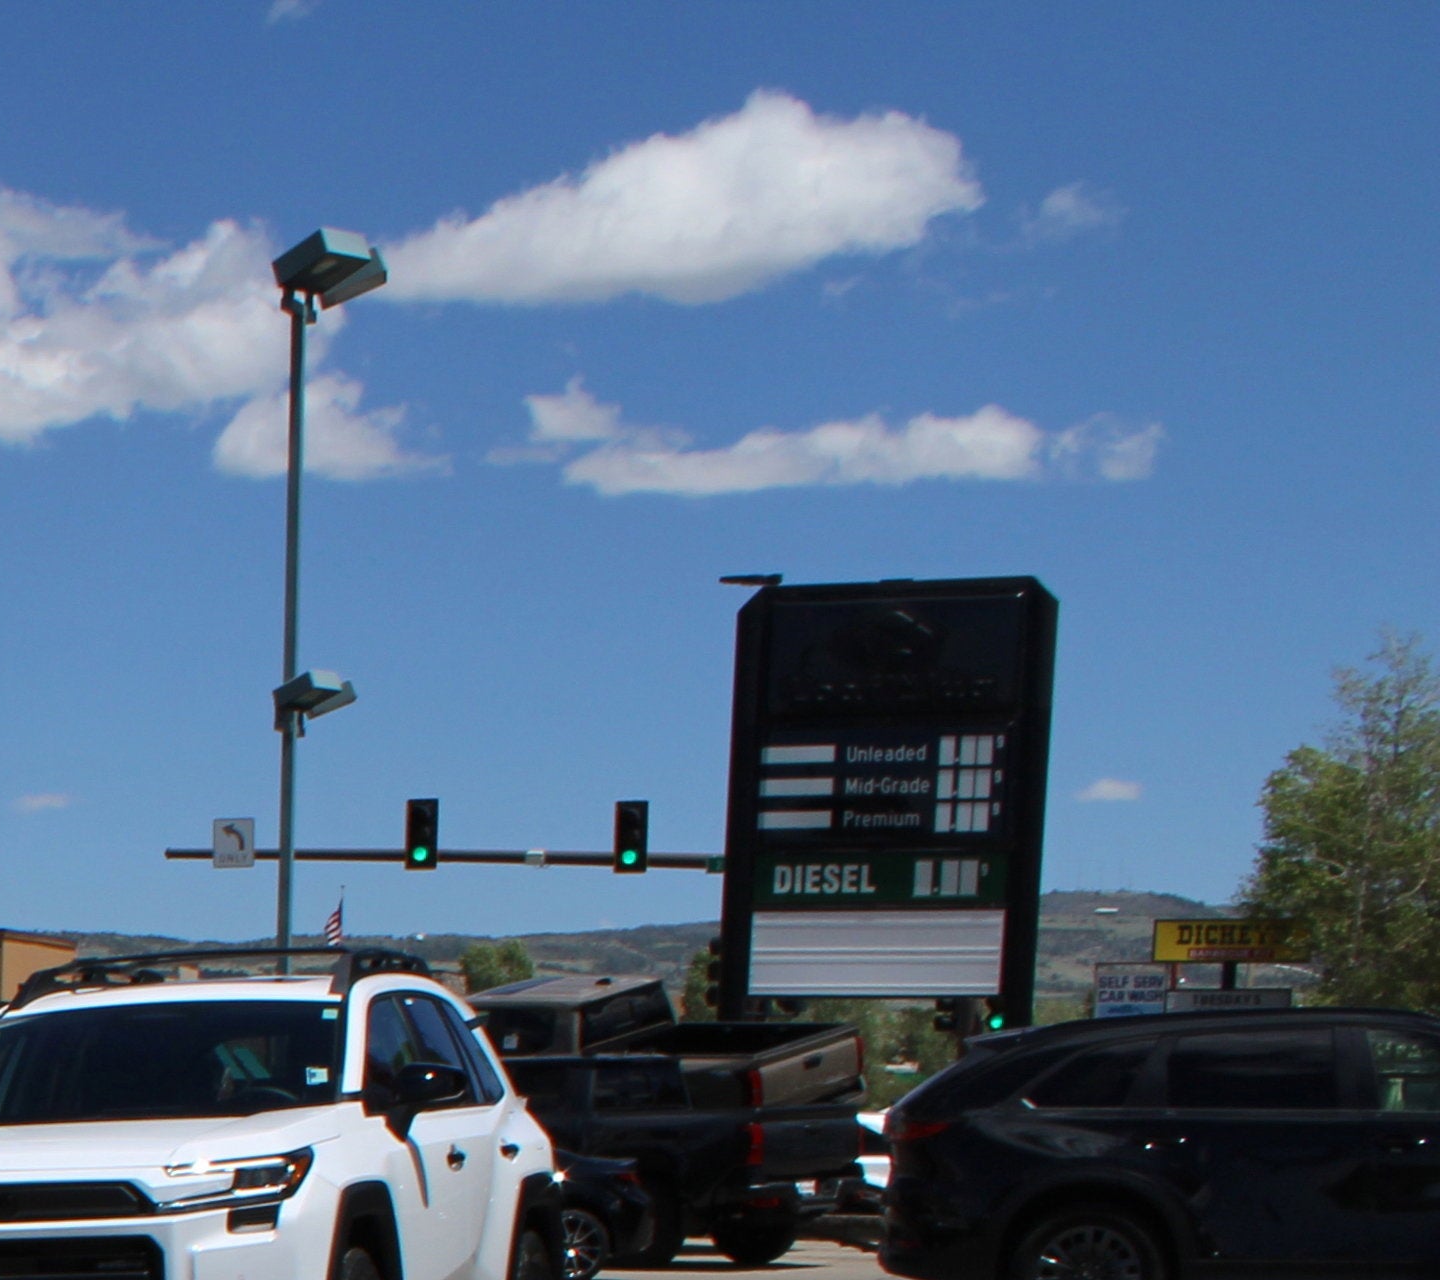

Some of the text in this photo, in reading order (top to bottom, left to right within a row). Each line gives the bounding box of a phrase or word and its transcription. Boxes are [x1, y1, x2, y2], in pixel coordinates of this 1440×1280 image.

[846, 745, 927, 762] Unleaded
[844, 777, 930, 795] Mid-Grade
[843, 810, 921, 827] Premium
[773, 864, 877, 894] DIESEL
[1099, 975, 1129, 988] SELF
[1099, 990, 1164, 1002] CAR WASH
